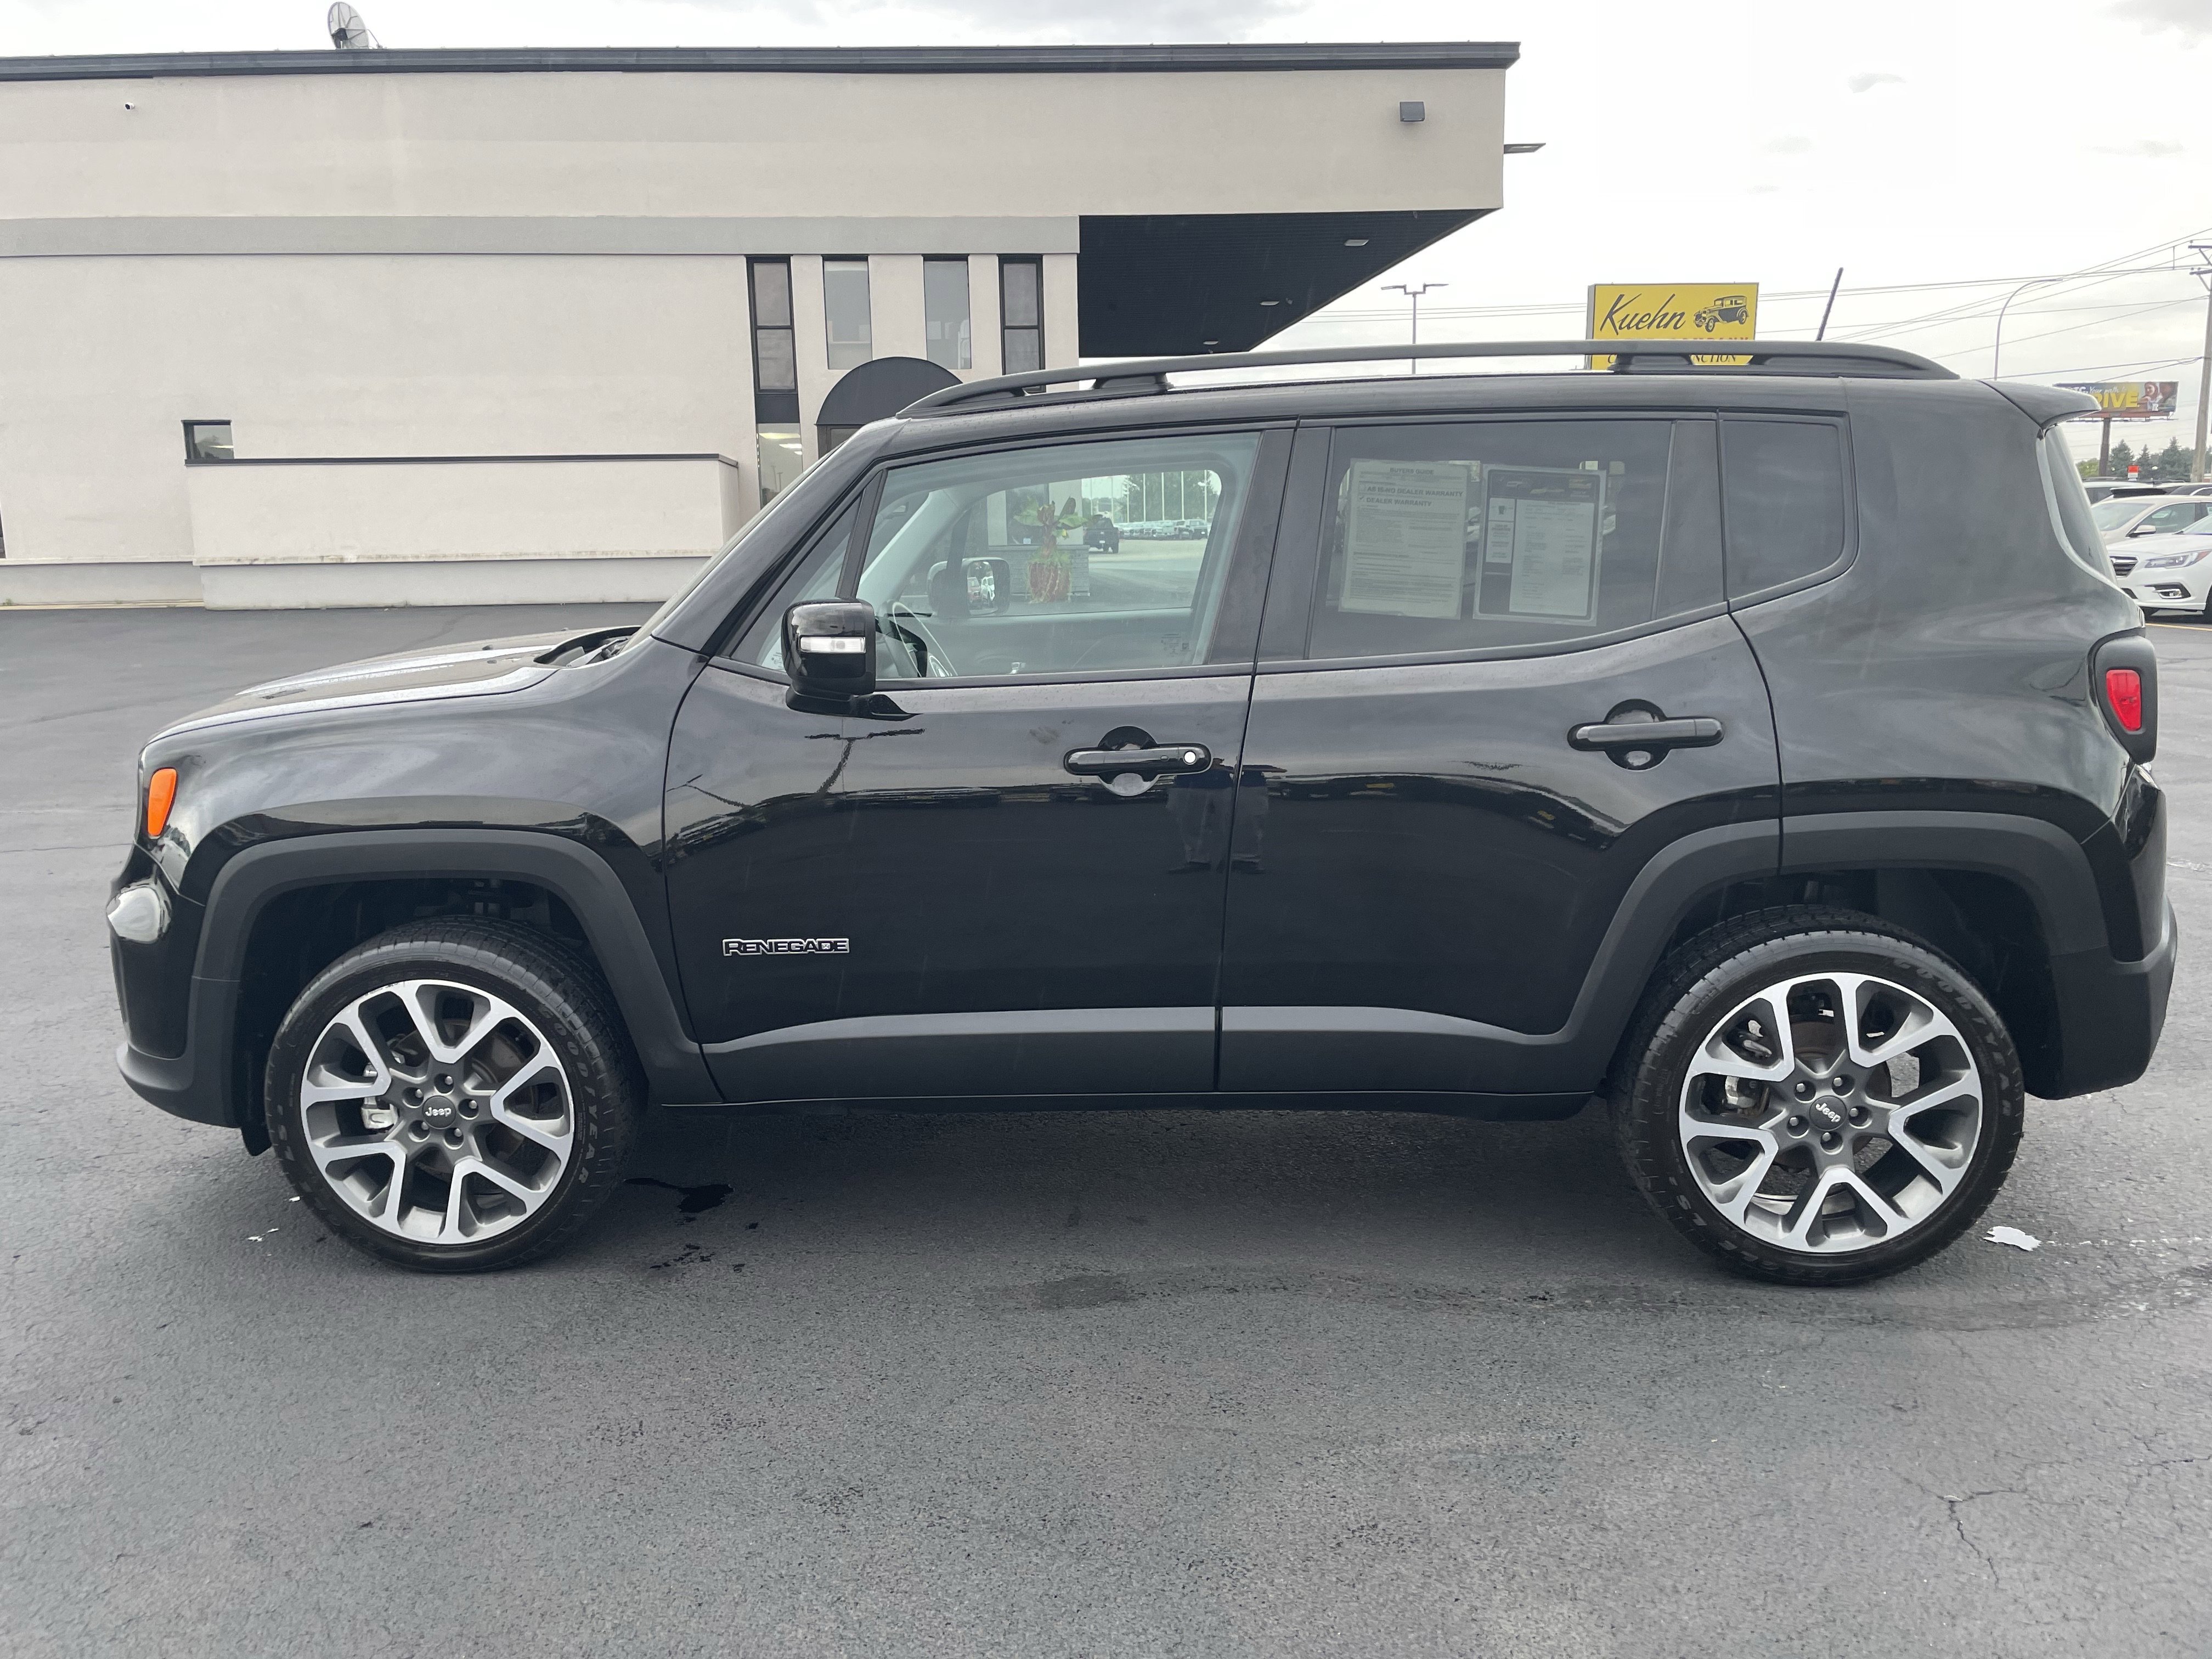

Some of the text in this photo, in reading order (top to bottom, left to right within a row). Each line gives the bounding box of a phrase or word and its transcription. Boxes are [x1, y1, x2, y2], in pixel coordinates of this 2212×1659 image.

[1599, 293, 1686, 335] Kuehn
[2091, 392, 2140, 408] RIVE.
[1394, 499, 1432, 507] WARRANTY
[722, 938, 850, 956] RENEGADE
[540, 1006, 597, 1183] GOODYEAR
[425, 1107, 452, 1117] Jeep
[1815, 1103, 1841, 1122] Jeep
